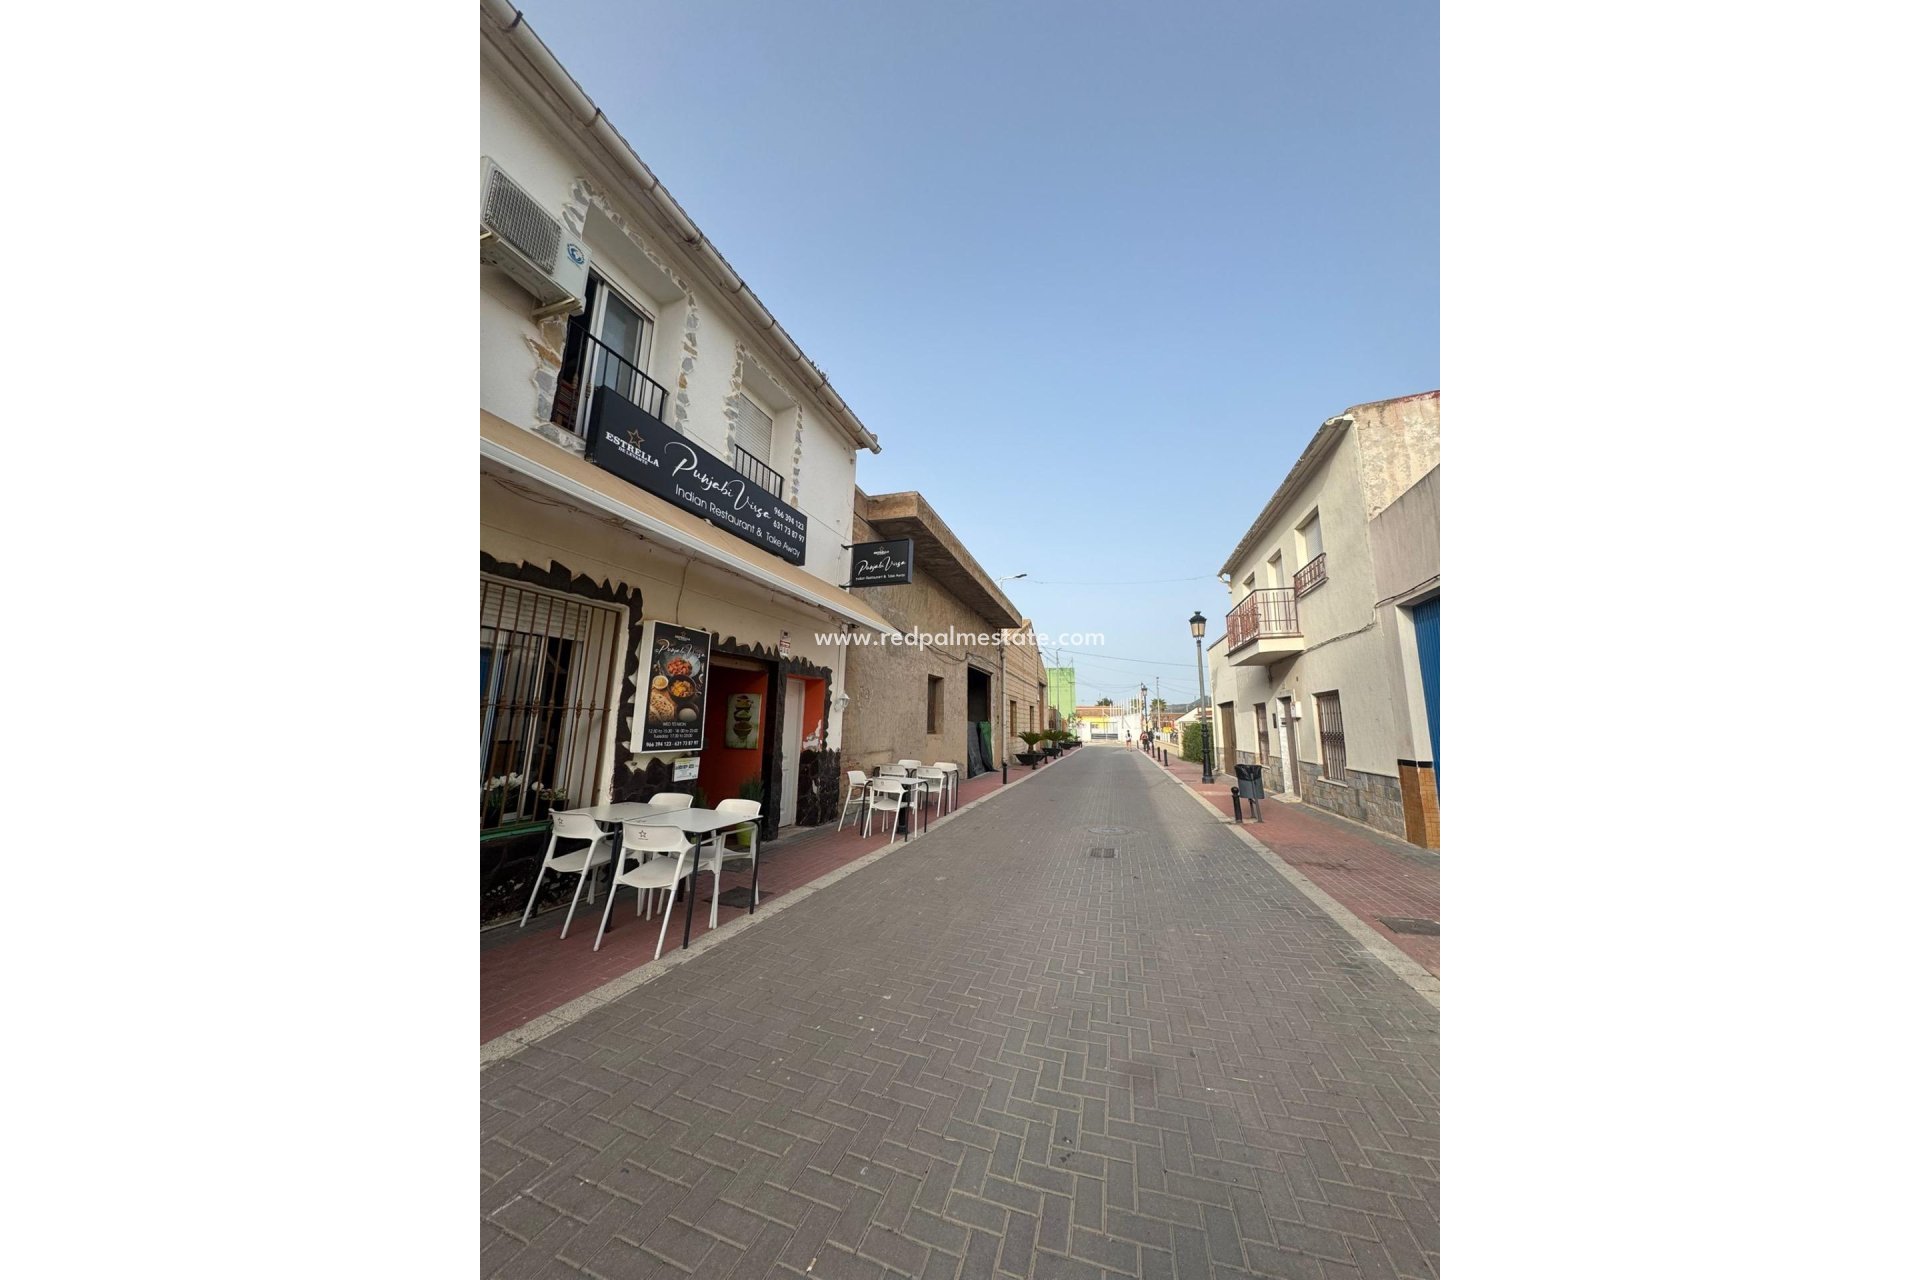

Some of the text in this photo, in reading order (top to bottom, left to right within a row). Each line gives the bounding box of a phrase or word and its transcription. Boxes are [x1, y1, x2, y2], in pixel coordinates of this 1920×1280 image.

[605, 431, 660, 468] ESTRELLA
[664, 441, 734, 497] Punjabi
[675, 484, 800, 558] Indian Restaurant & Take Away
[773, 520, 783, 531] 631
[784, 525, 791, 536] 73
[798, 534, 805, 543] 97
[774, 506, 804, 531] 966 394 123
